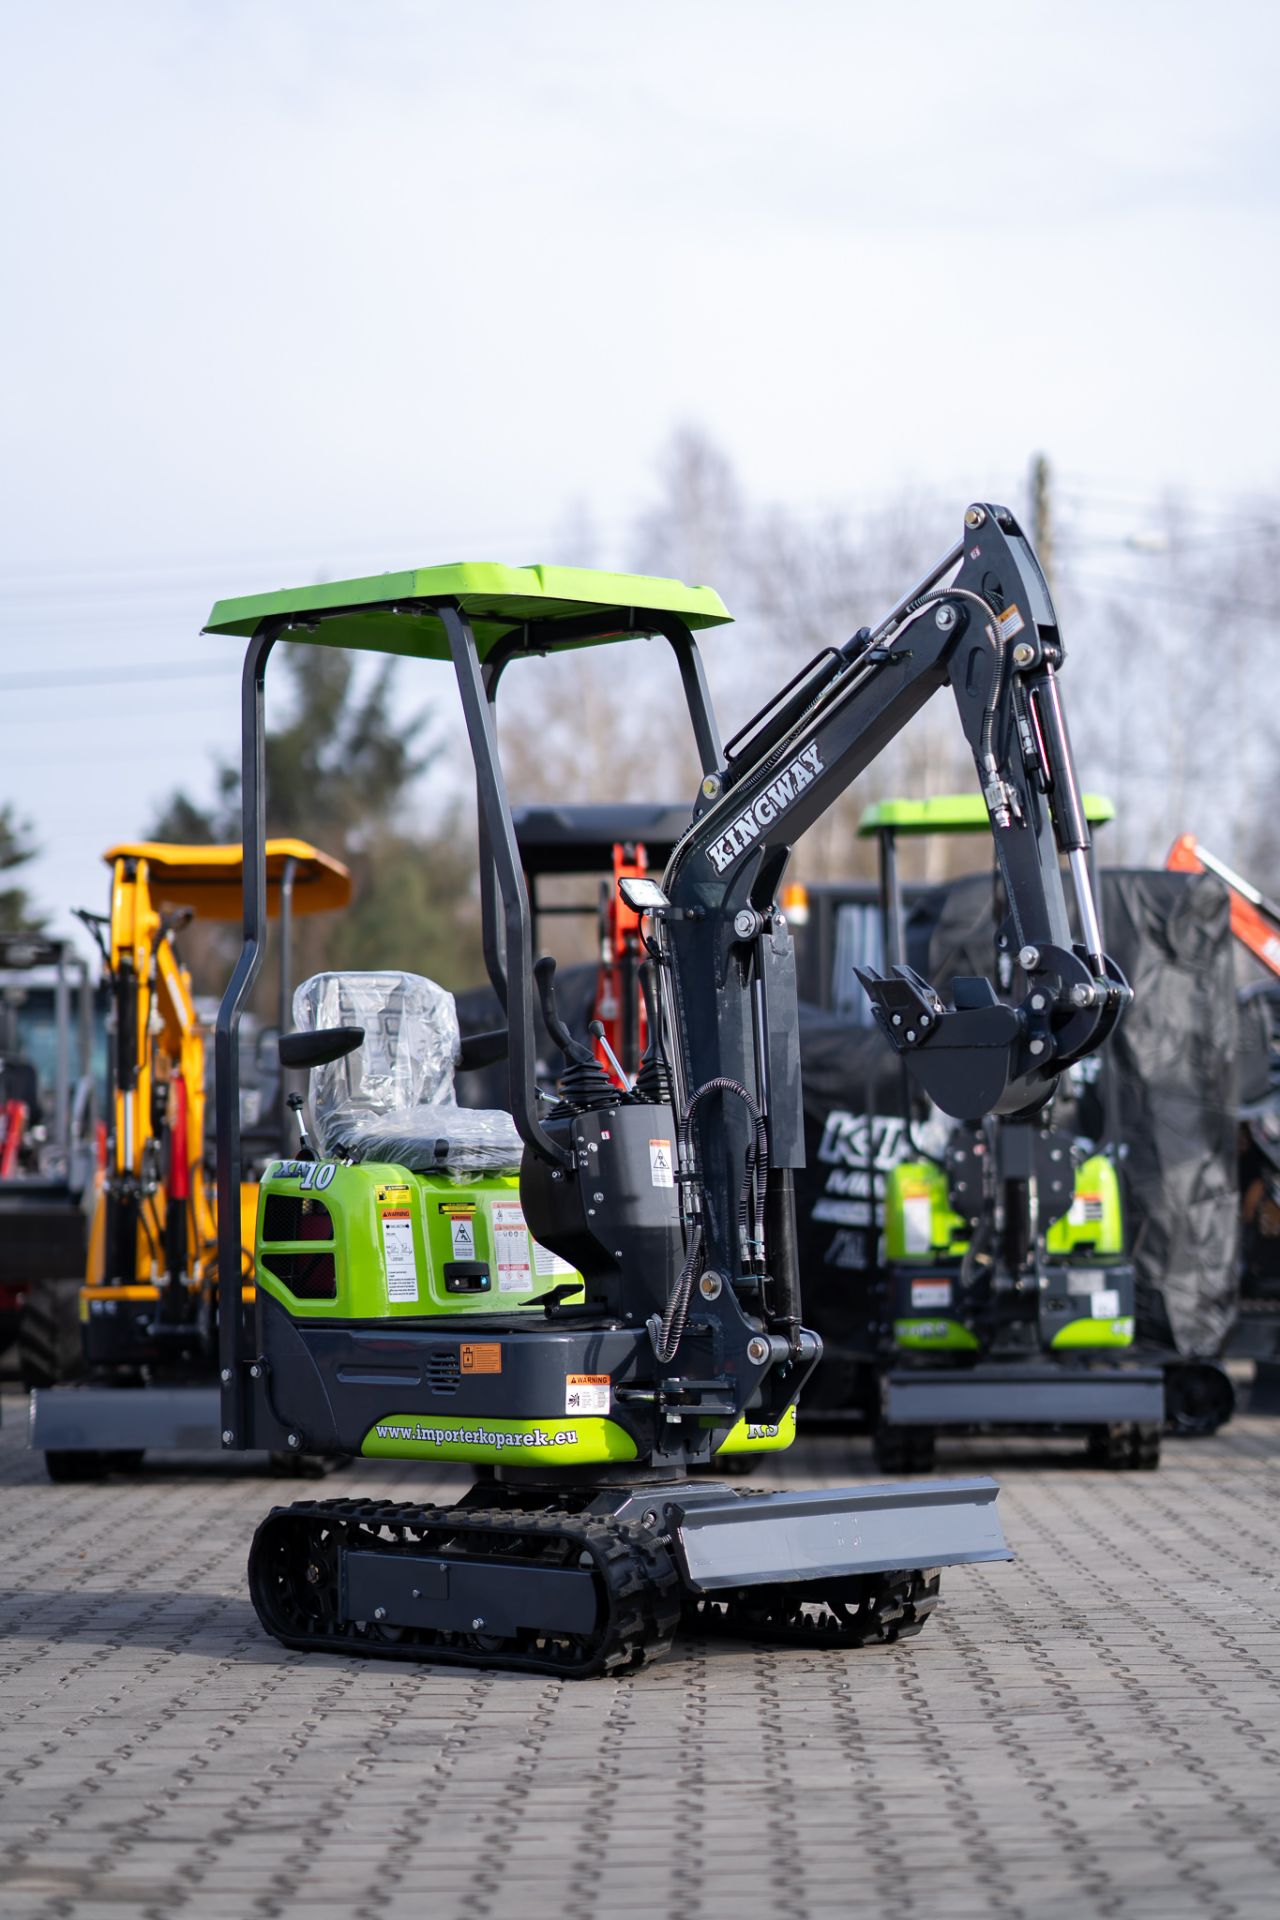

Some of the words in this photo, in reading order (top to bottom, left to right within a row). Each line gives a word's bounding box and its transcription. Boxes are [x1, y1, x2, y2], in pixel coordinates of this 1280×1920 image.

[707, 742, 825, 874] KINGWAY
[577, 1376, 608, 1384] WARNING
[376, 1423, 579, 1450] www.importerkoparek.eu
